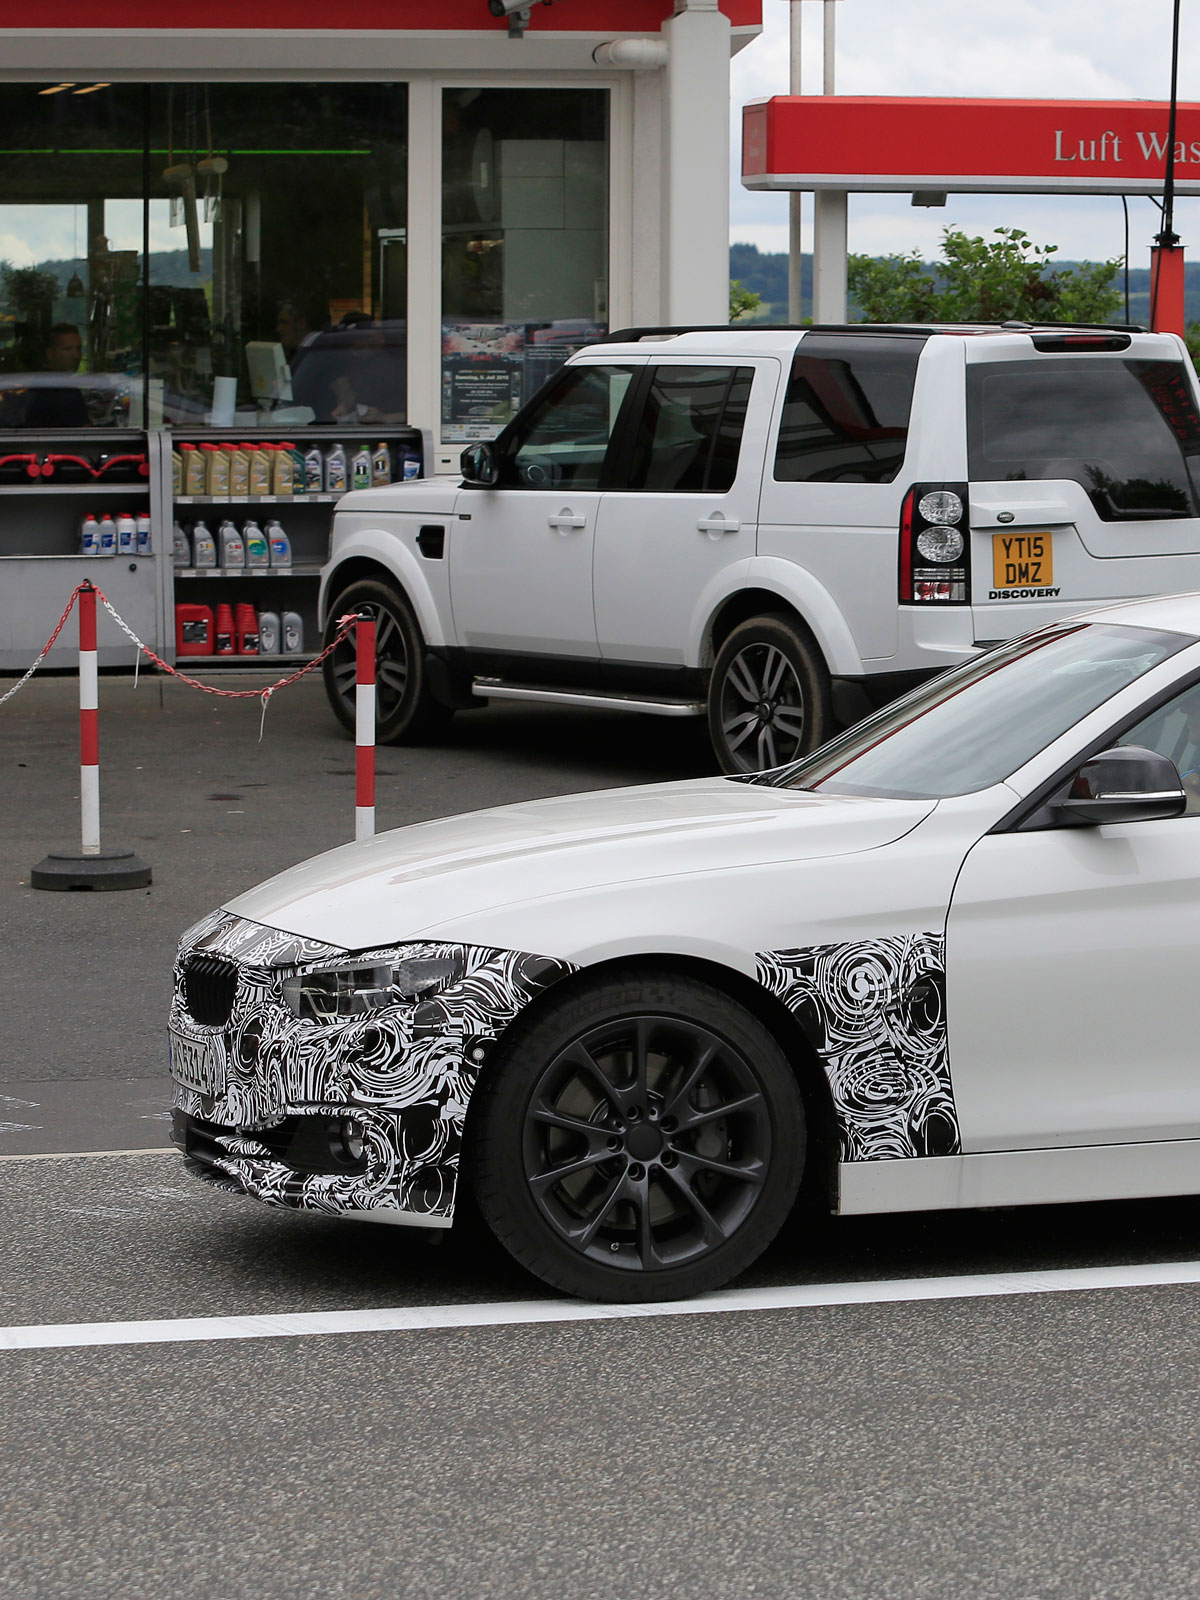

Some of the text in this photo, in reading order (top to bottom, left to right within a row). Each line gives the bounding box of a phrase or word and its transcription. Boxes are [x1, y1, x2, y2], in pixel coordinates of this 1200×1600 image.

[1054, 130, 1122, 161] Luft
[1002, 536, 1044, 559] YT15
[1005, 562, 1042, 584] DMZ
[988, 587, 1061, 600] DISCOVERY
